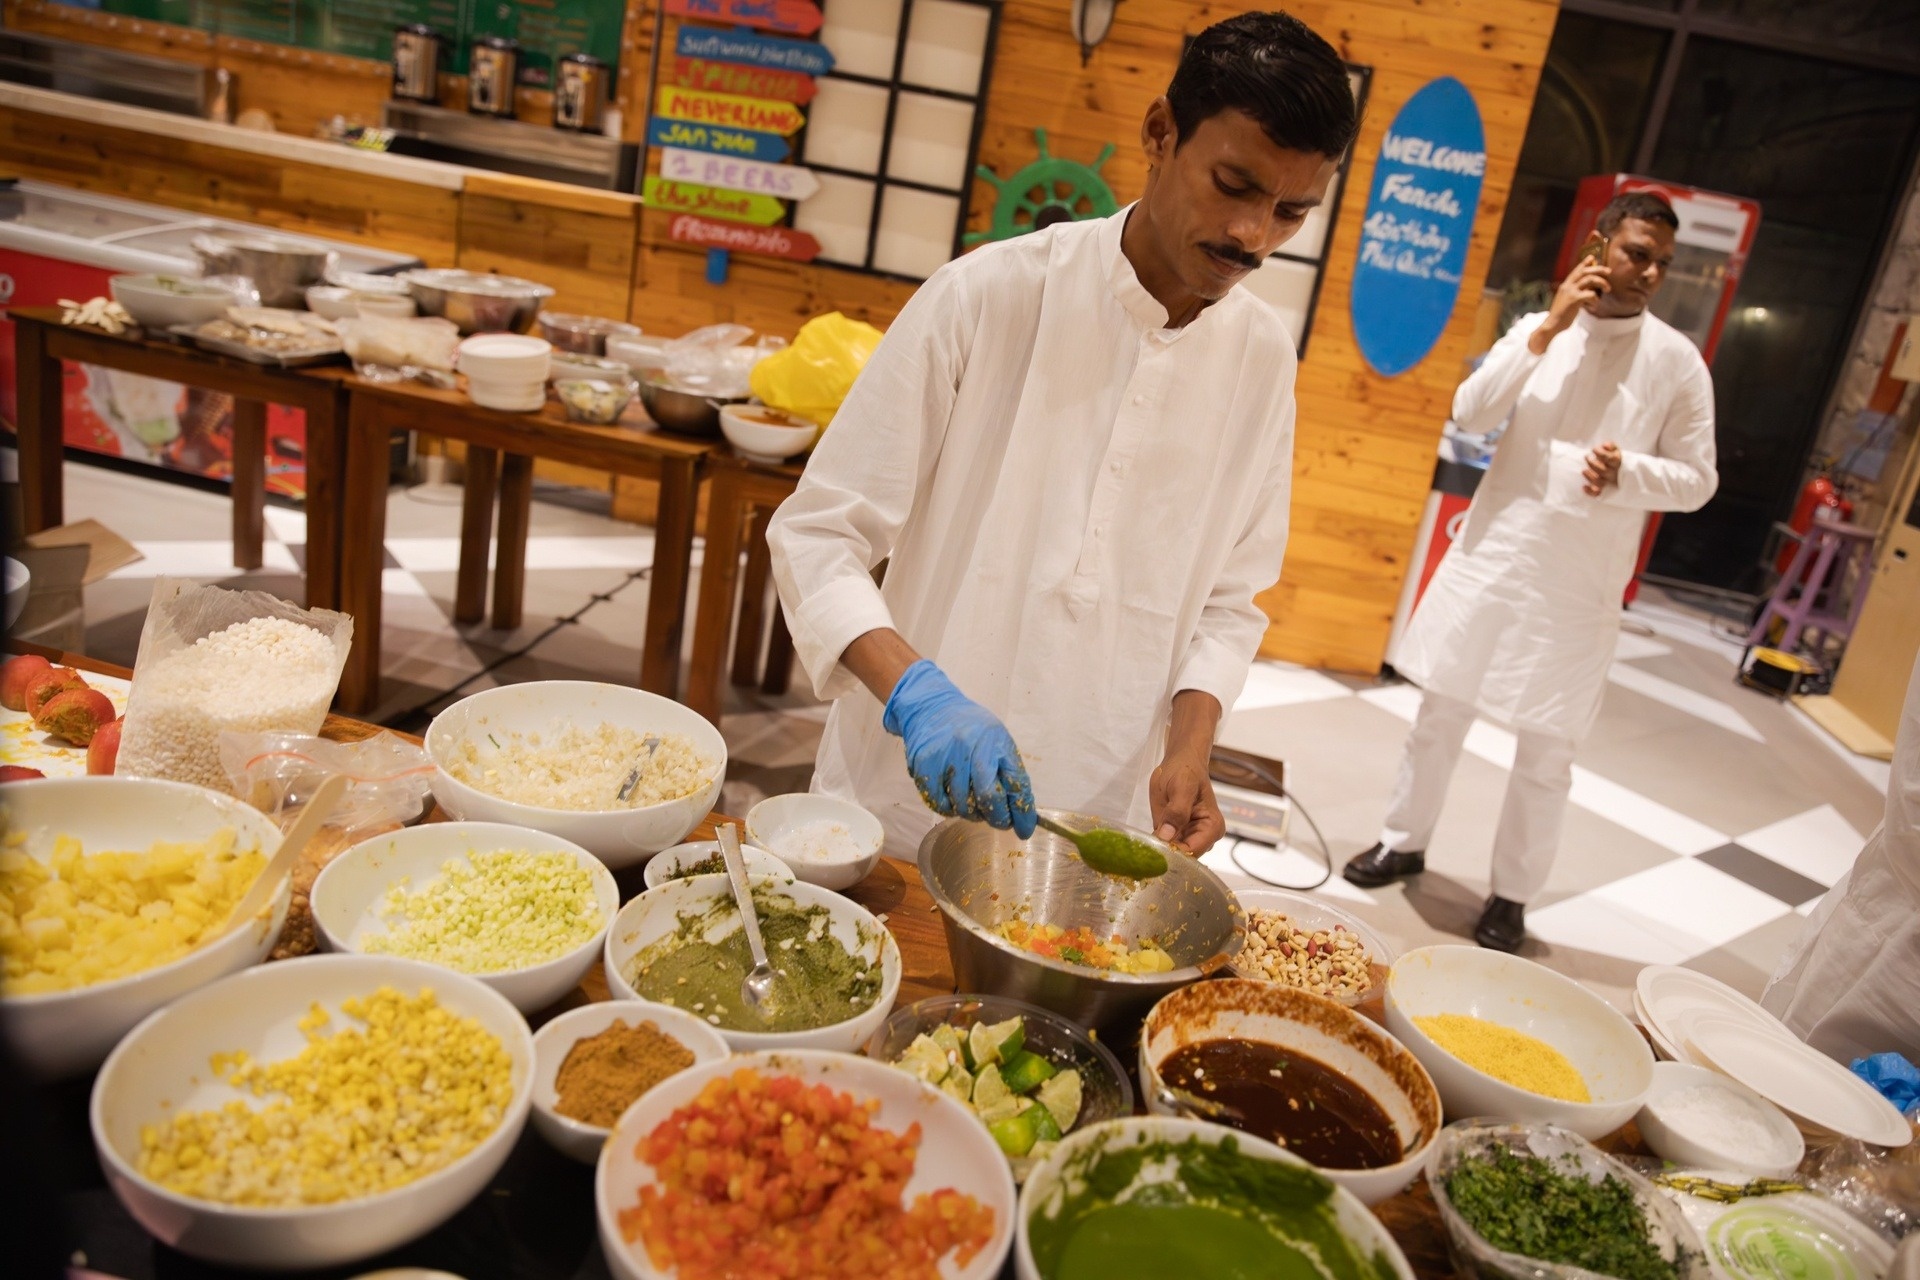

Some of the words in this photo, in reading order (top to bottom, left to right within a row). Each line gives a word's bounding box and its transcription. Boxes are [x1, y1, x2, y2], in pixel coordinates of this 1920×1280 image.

[671, 95, 797, 134] NEVERLAND
[1382, 131, 1487, 177] WELCOME
[703, 158, 795, 193] BEERS
